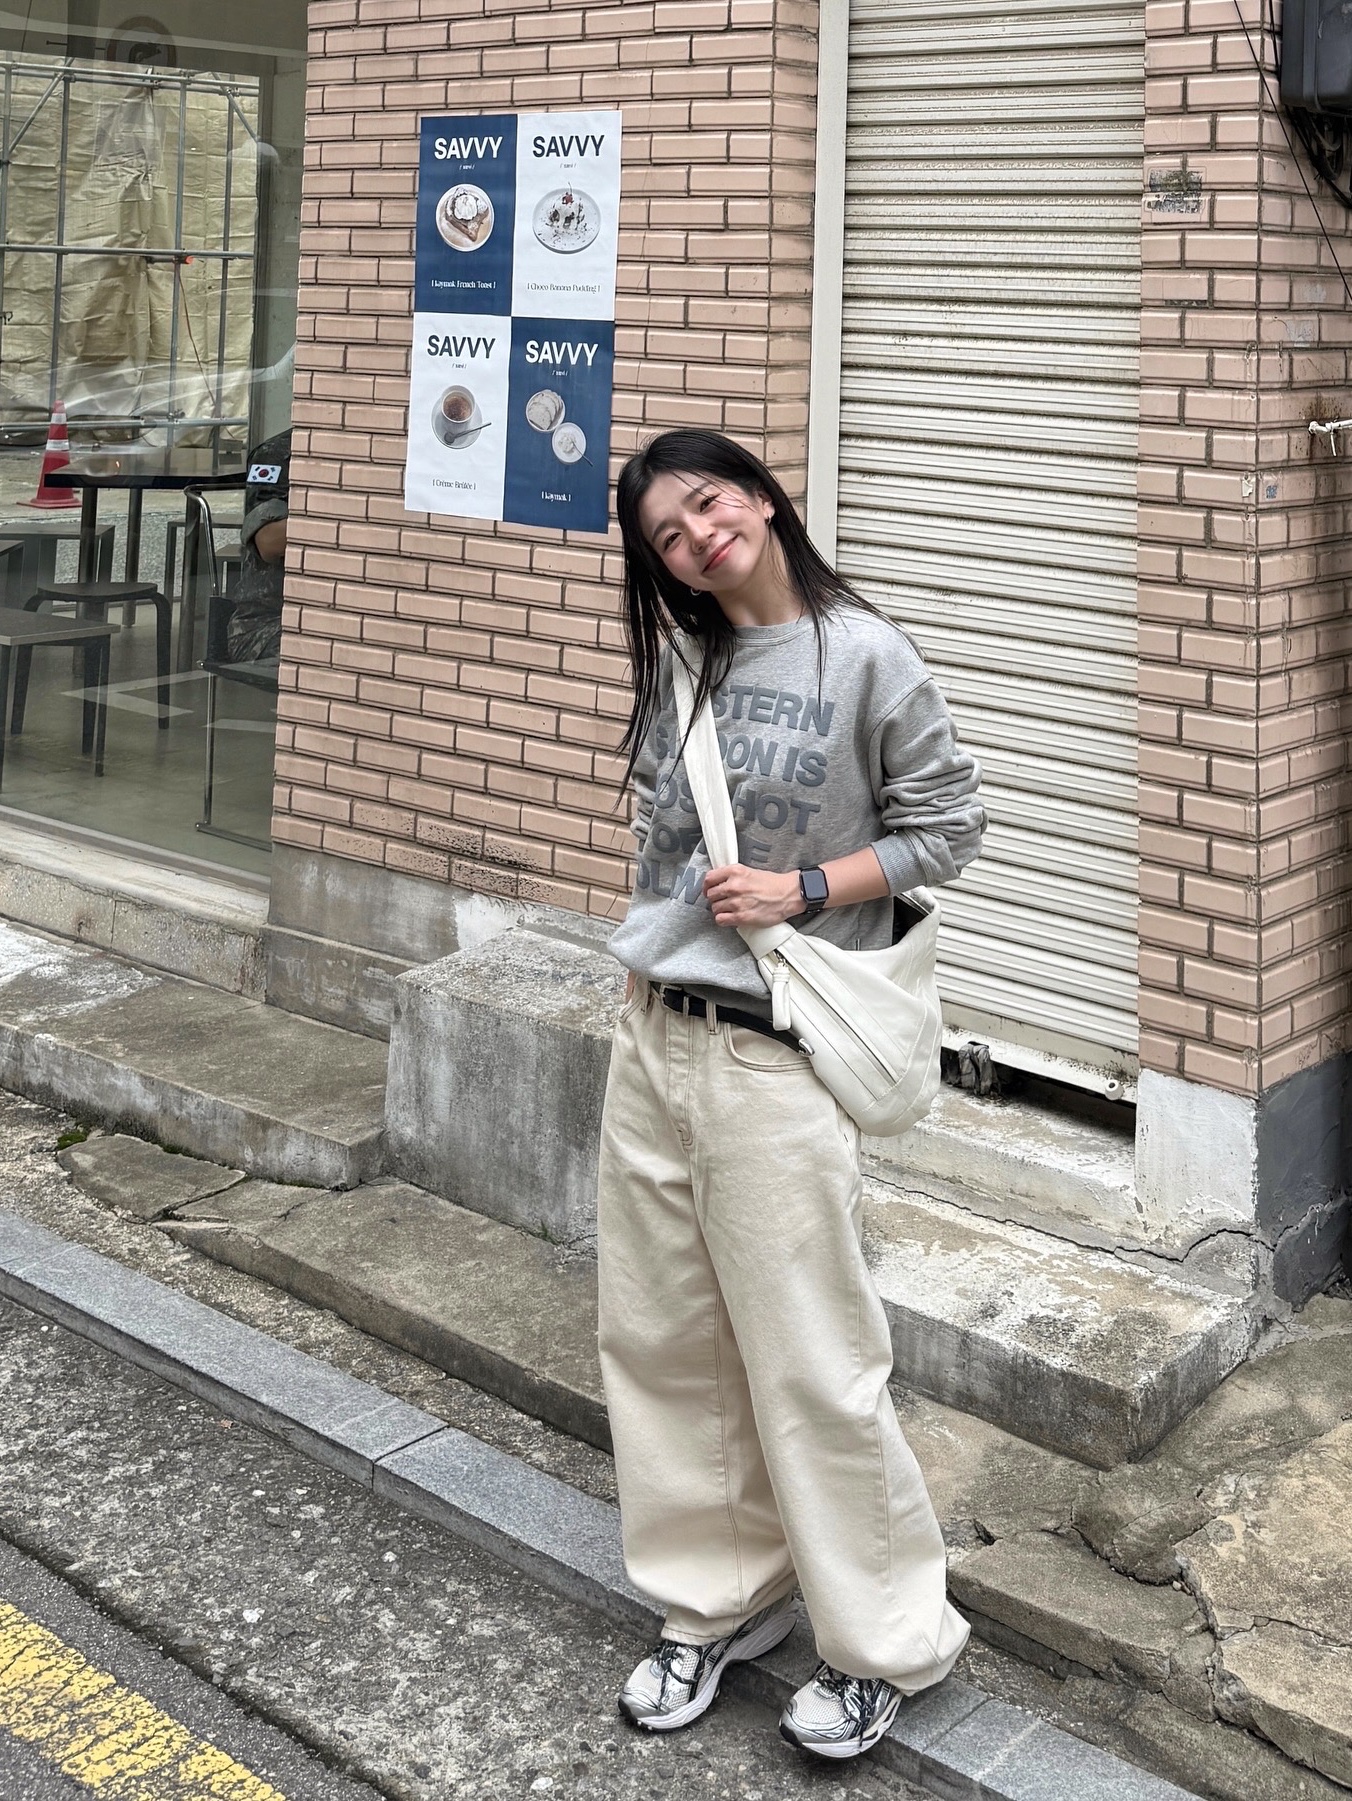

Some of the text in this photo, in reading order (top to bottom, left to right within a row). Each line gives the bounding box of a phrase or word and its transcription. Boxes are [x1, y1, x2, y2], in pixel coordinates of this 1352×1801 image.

[434, 136, 503, 159] SAVVY
[532, 135, 605, 158] SAVVY
[427, 334, 496, 359] SAVVY
[525, 340, 599, 367] SAVVY
[782, 746, 828, 787] IS
